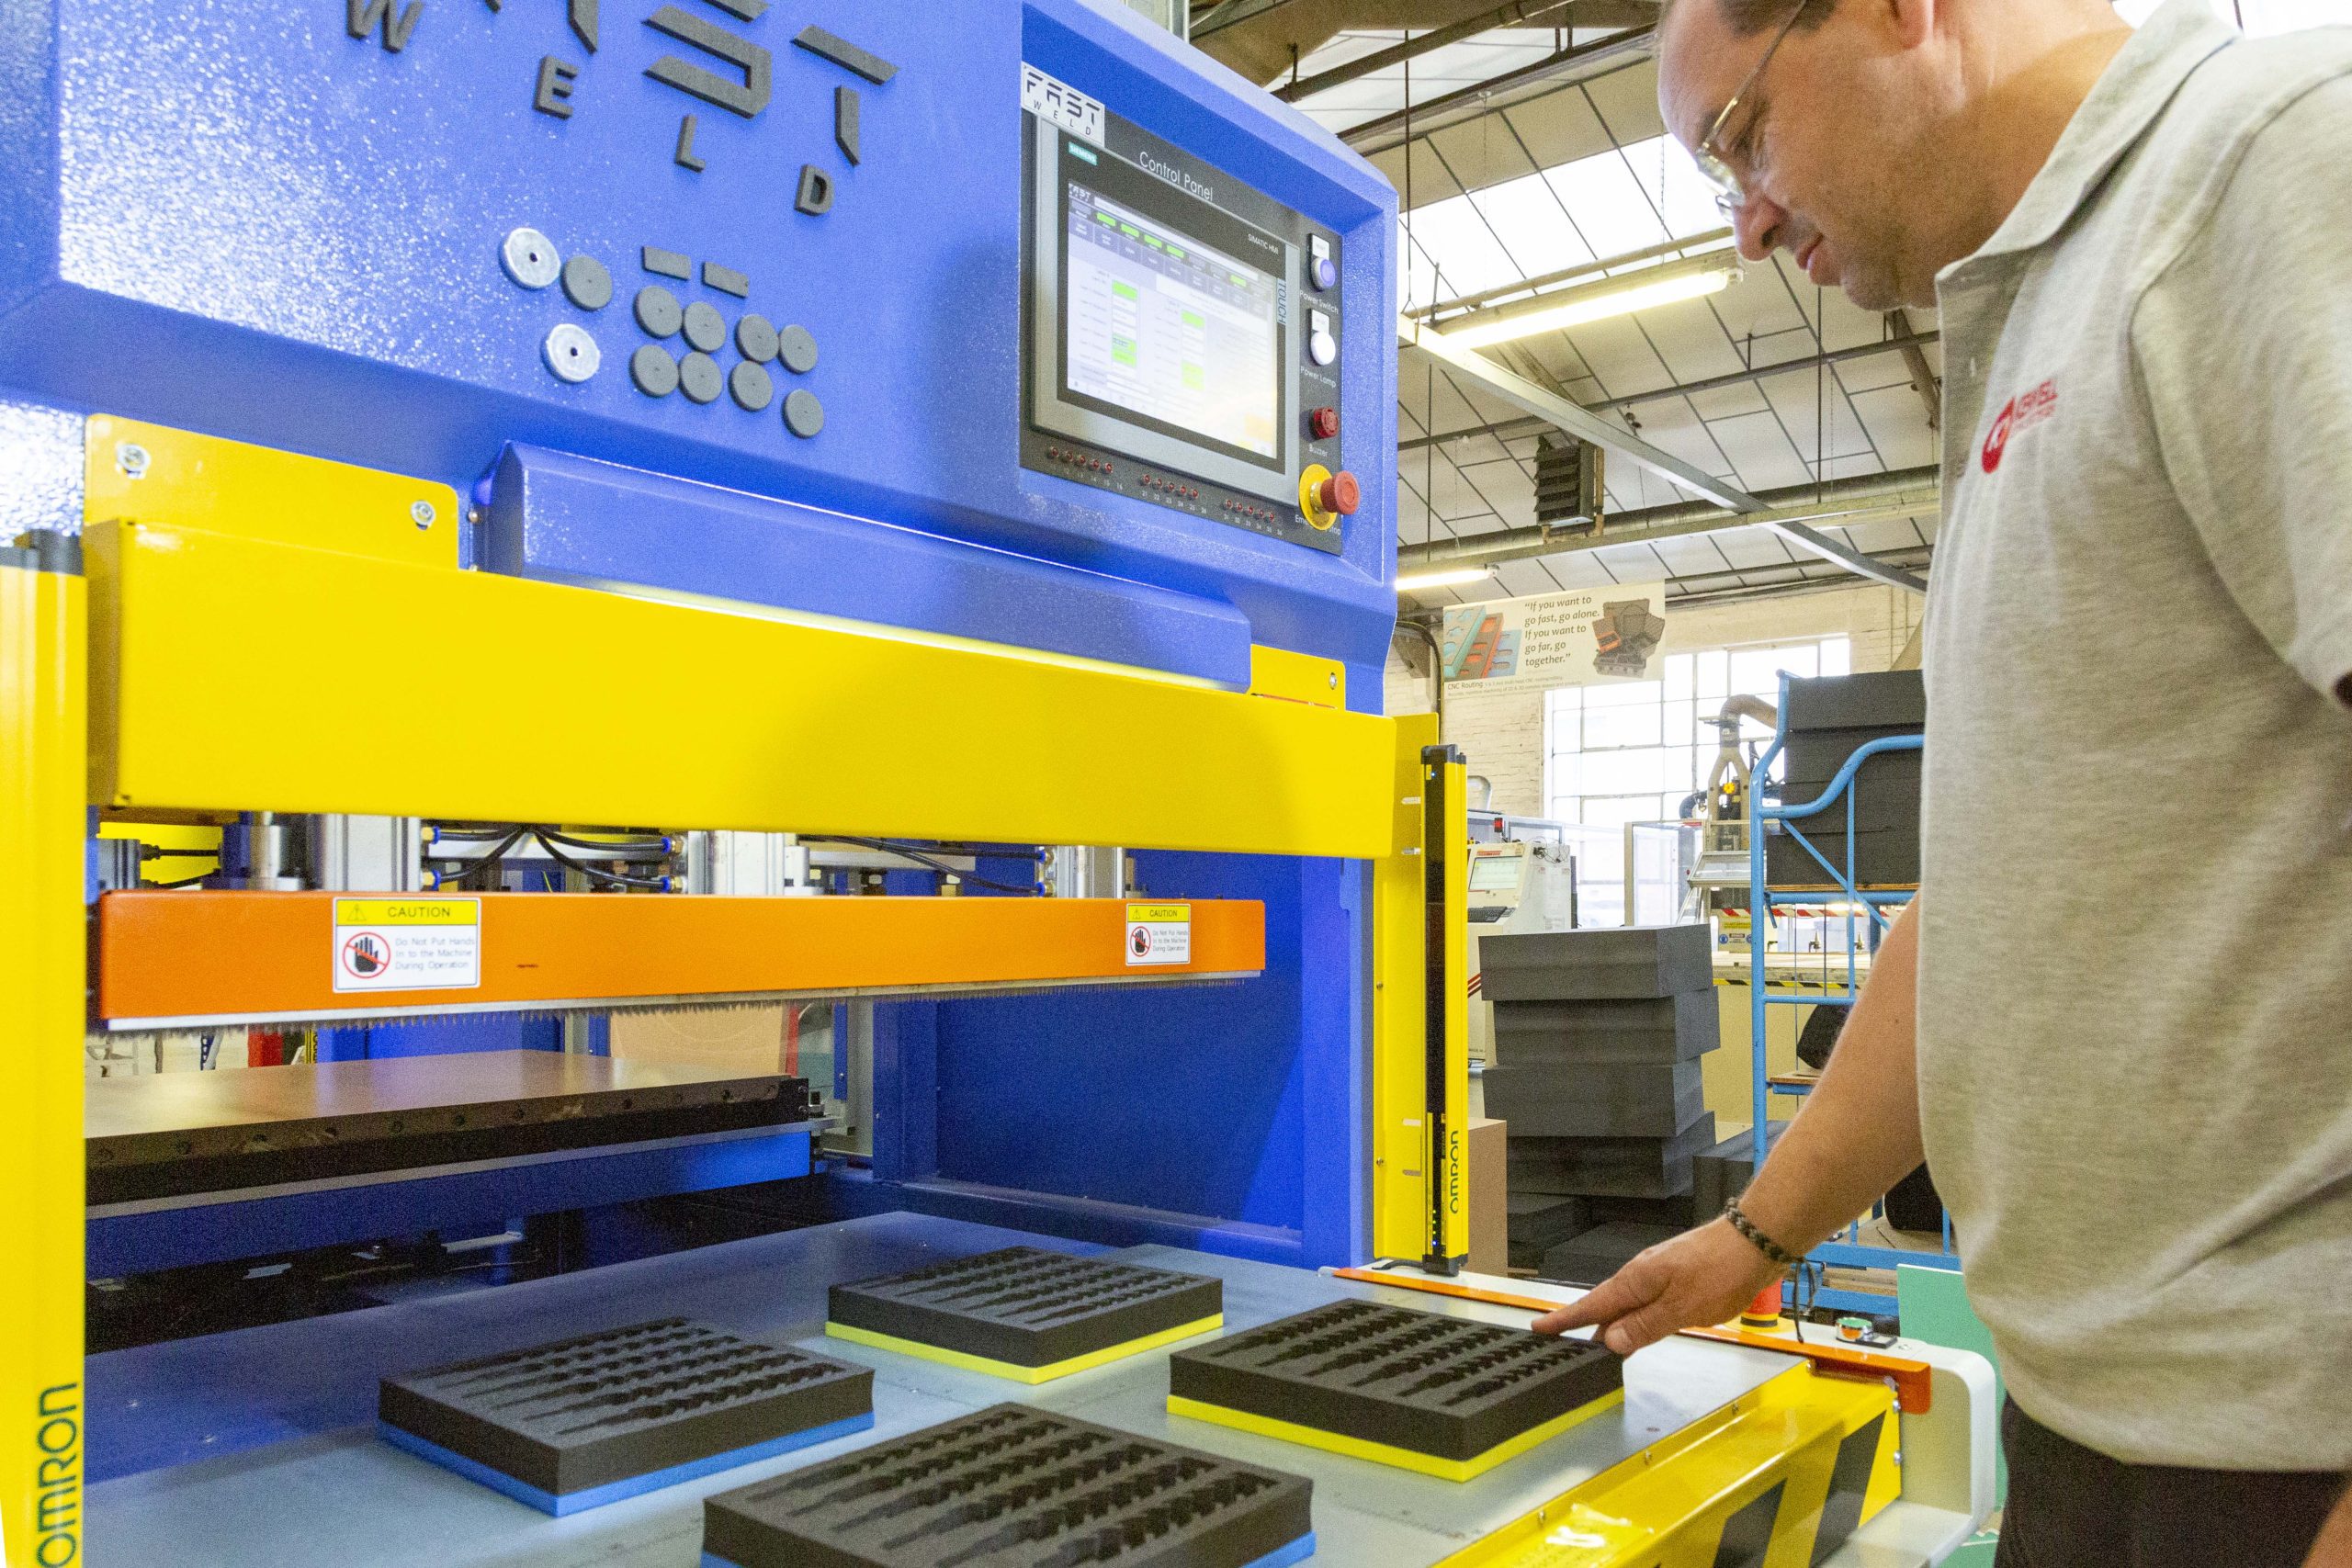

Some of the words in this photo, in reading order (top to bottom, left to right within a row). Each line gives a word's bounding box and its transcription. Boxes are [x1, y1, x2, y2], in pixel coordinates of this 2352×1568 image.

[1026, 71, 1101, 126] FAST
[1139, 151, 1181, 185] Control
[1184, 173, 1213, 201] Panel
[1248, 233, 1268, 250] SIMATIC
[1268, 244, 1279, 255] HMI
[1277, 281, 1287, 325] TOUCH
[1299, 289, 1318, 306] Power
[1318, 299, 1339, 314] Switch
[1300, 366, 1320, 382] Power
[1320, 371, 1337, 389] Lamp
[1539, 601, 1555, 612] you
[1556, 597, 1579, 607] want
[1582, 596, 1592, 604] to
[1524, 617, 1536, 628] go
[1538, 614, 1557, 626] fast,
[1558, 613, 1571, 624] go
[1573, 610, 1600, 620] alone.
[1525, 629, 1532, 640] If
[1533, 629, 1550, 640] you
[1552, 626, 1575, 636] want
[1577, 625, 1587, 633] to
[1525, 645, 1536, 656] go
[1538, 641, 1553, 653] far,
[1555, 641, 1566, 652] go
[388, 907, 451, 918] CAUTION
[1149, 909, 1178, 918] CAUTION
[395, 937, 408, 946] Do
[411, 937, 427, 946] Not
[431, 937, 446, 946] Put
[448, 937, 475, 946] Hands
[437, 949, 472, 957] Machine
[395, 961, 424, 971] During
[427, 961, 469, 970] Operation
[36, 1382, 77, 1568] OMRON
